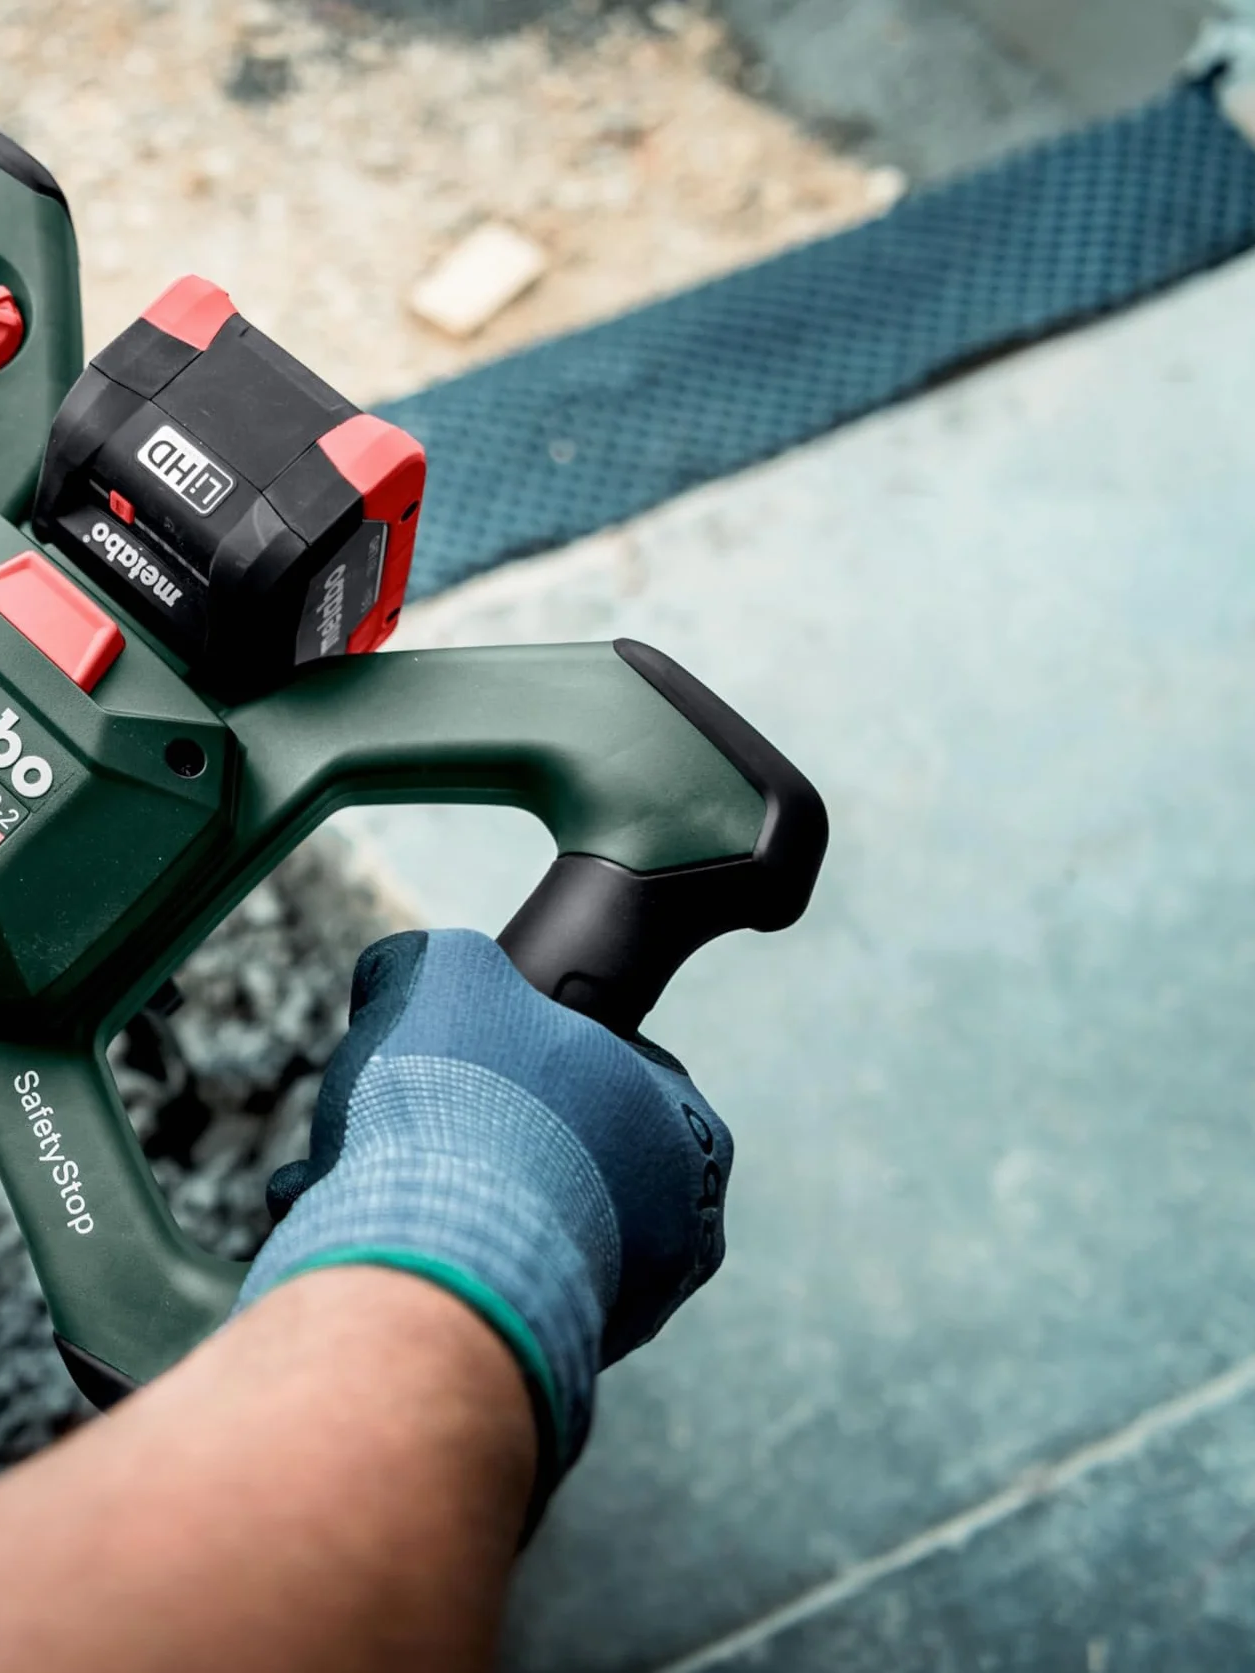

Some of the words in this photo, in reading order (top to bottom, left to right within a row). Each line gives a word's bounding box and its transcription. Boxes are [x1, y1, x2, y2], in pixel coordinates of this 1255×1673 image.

[148, 440, 222, 505] LiHD
[91, 522, 183, 607] metabo
[14, 1070, 94, 1235] SafetyStop
